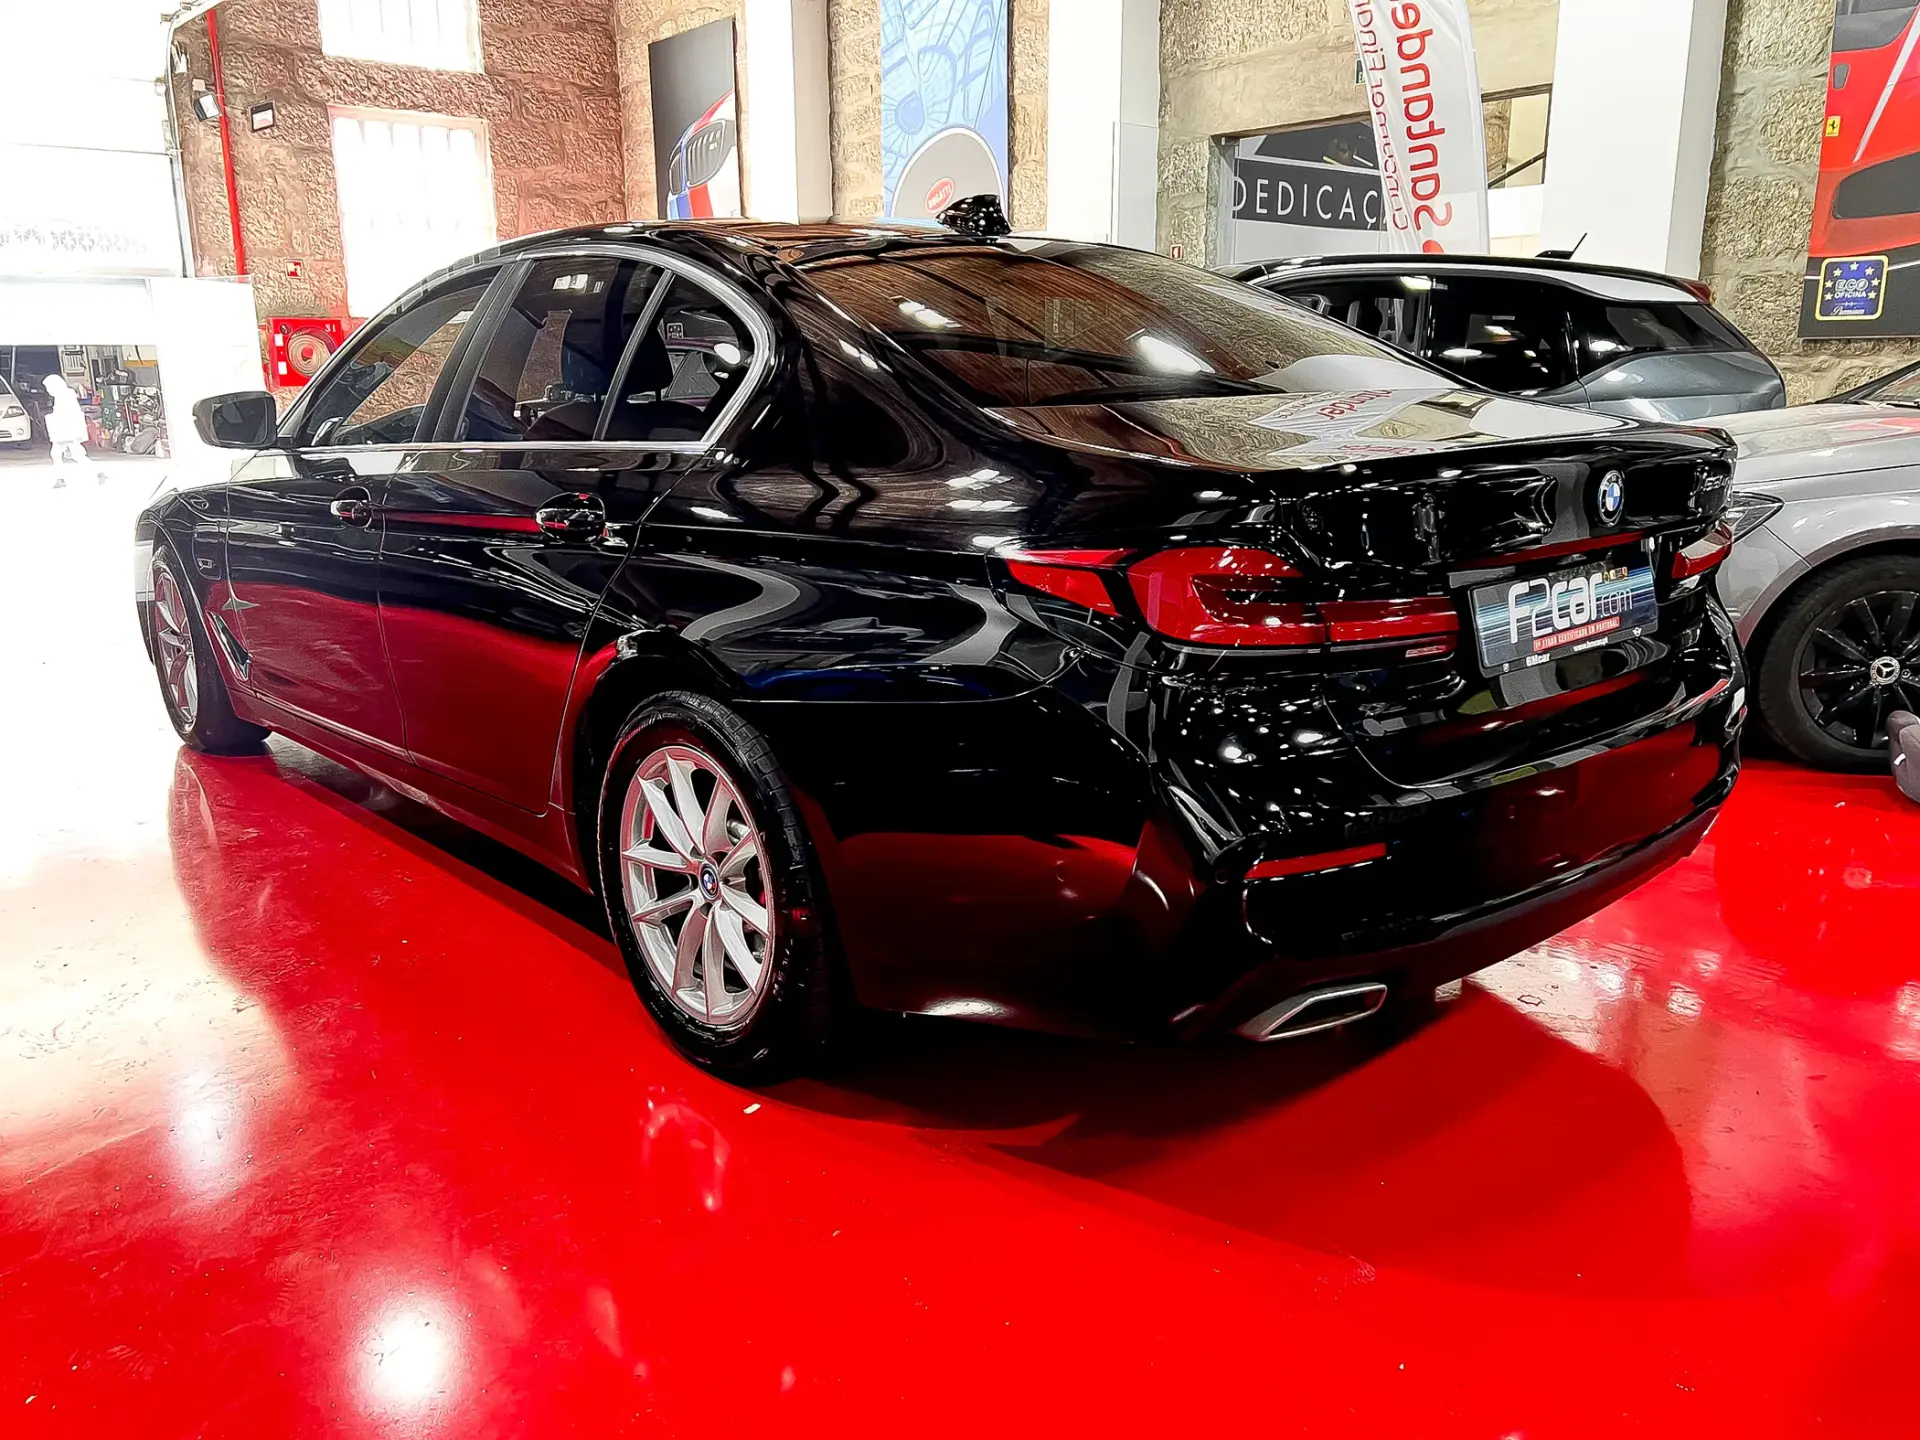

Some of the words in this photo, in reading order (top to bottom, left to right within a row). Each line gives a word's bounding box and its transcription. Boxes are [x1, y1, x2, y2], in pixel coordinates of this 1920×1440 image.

[1232, 176, 1387, 230] DEDICAÇ
[1835, 278, 1868, 291] ECO
[1834, 290, 1867, 299] OFICINA
[1830, 306, 1865, 315] Premium
